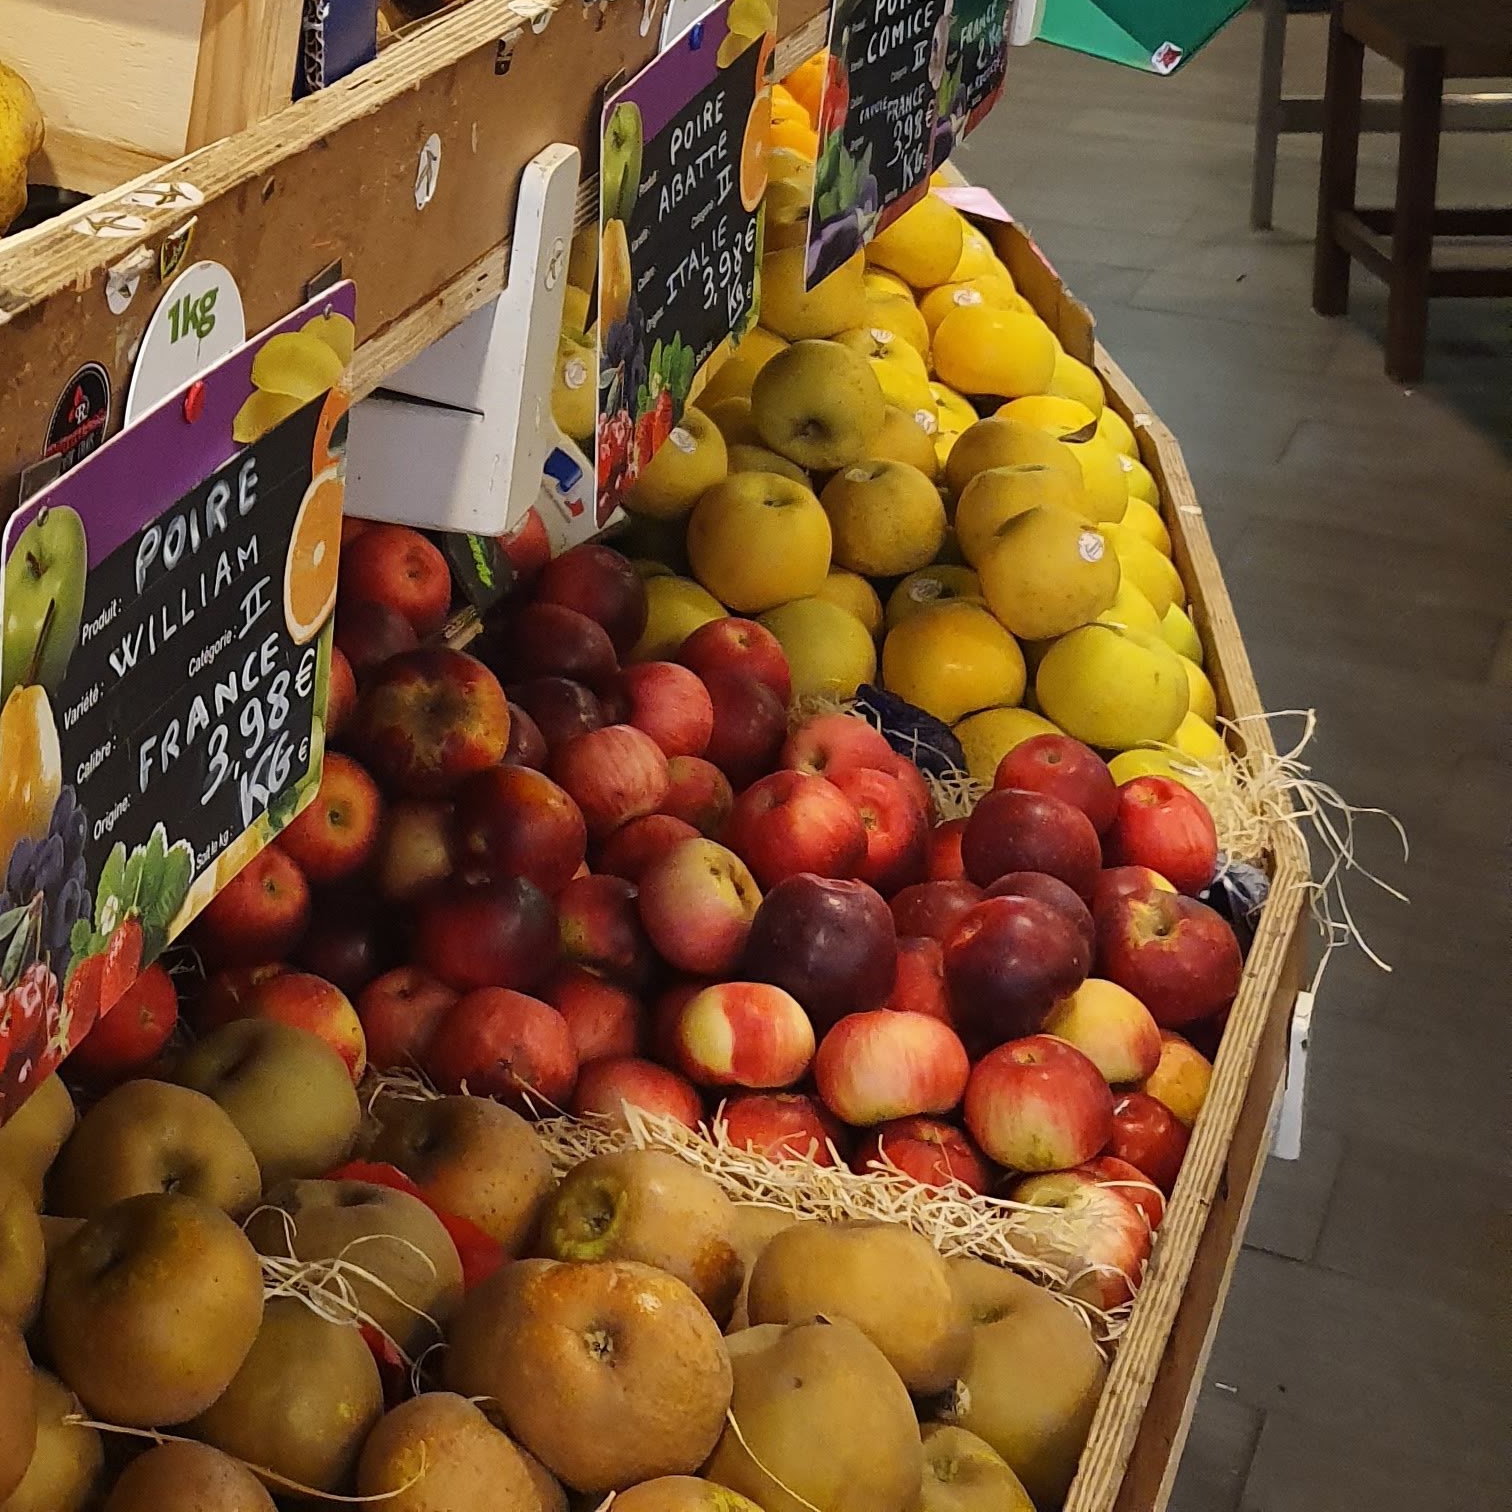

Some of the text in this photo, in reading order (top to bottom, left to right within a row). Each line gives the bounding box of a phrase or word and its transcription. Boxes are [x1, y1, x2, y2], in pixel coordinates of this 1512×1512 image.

[867, 0, 935, 64] COMICE
[670, 90, 726, 166] POIRE
[886, 82, 926, 124] FRANCE
[658, 129, 728, 223] ABATTE
[666, 214, 728, 306] ITALIE
[167, 285, 220, 345] 1kg
[134, 456, 259, 595] POIRE
[108, 534, 259, 678] WILLIAM
[138, 631, 281, 794] FRANCE
[239, 729, 295, 829] KG
